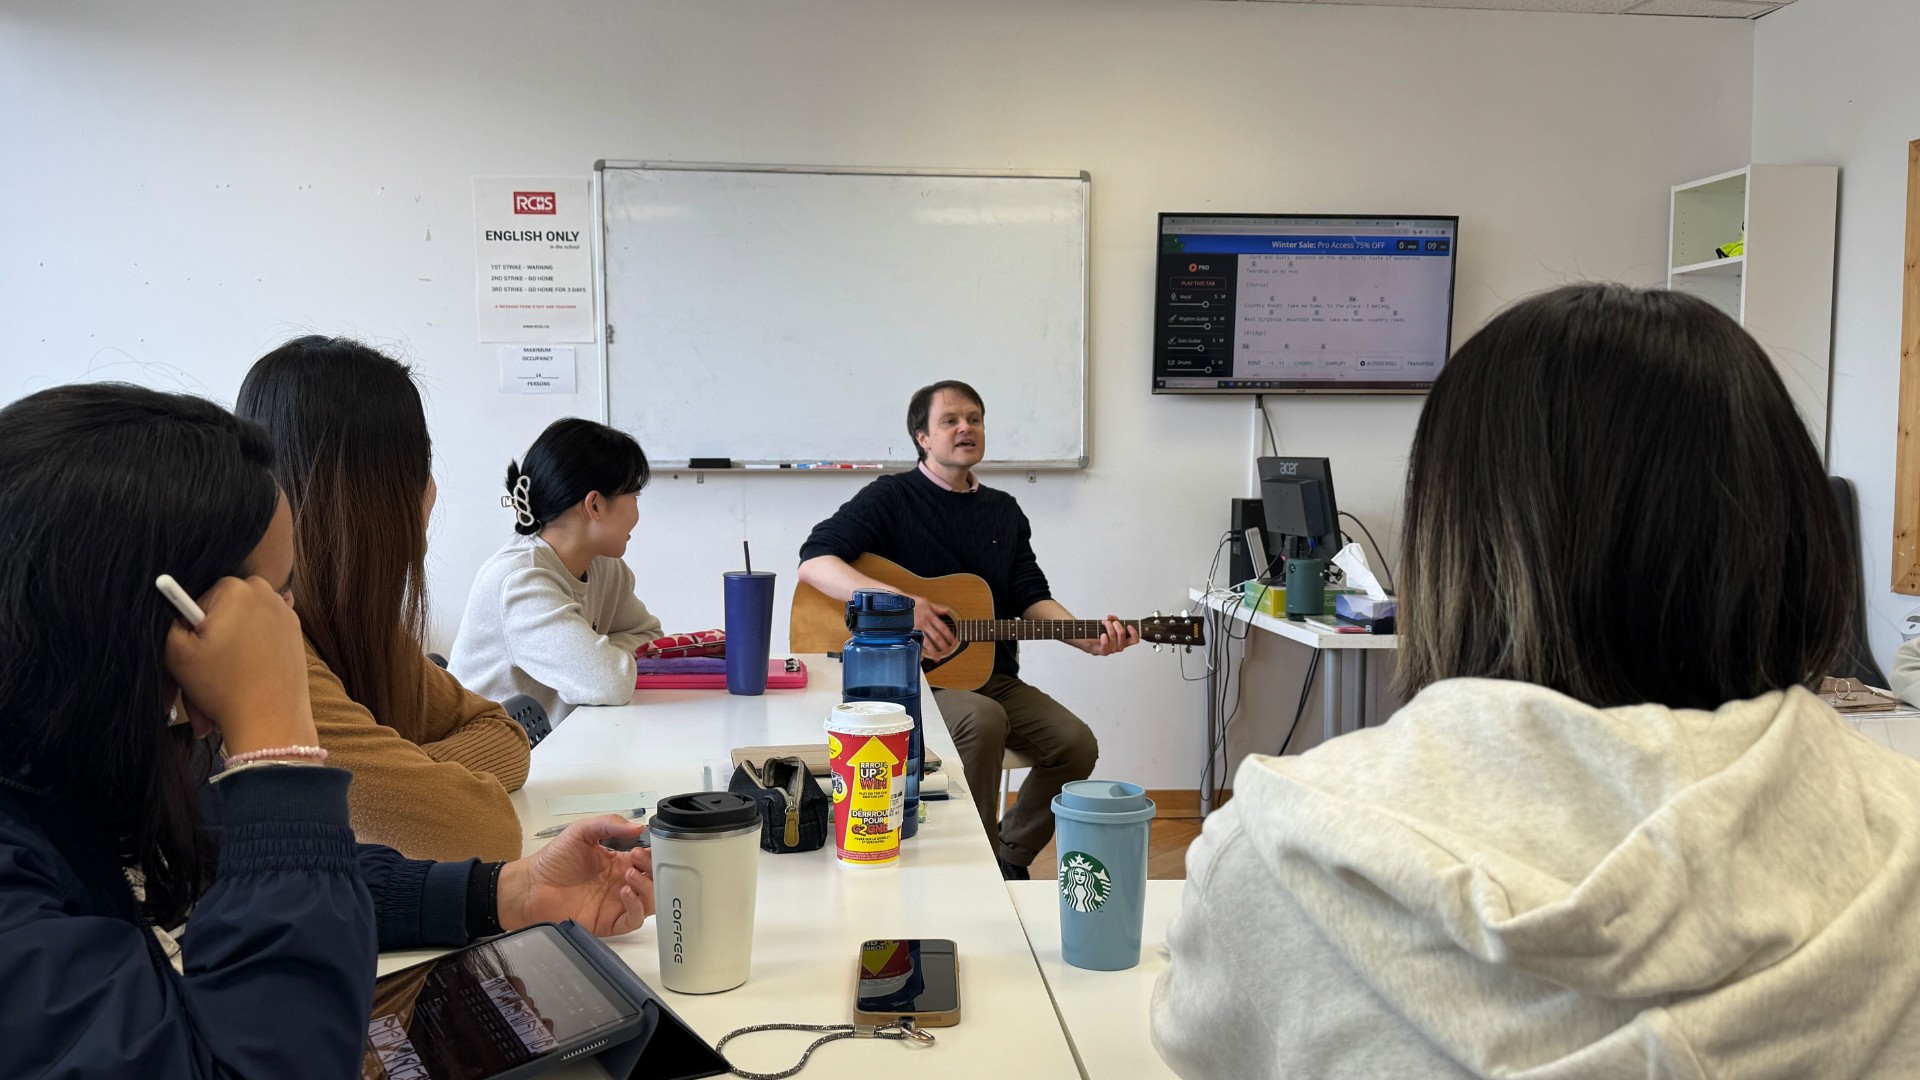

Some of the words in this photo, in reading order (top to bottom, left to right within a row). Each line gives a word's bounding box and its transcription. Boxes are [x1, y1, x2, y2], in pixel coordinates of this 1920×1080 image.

[486, 230, 542, 242] ENGLISH
[546, 230, 580, 242] ONLY
[1280, 462, 1298, 475] acer
[860, 769, 877, 778] UP
[860, 778, 887, 789] WIN
[852, 808, 888, 817] DÉRRROU
[852, 824, 888, 836] G2GNE
[673, 898, 682, 964] COFFEE
